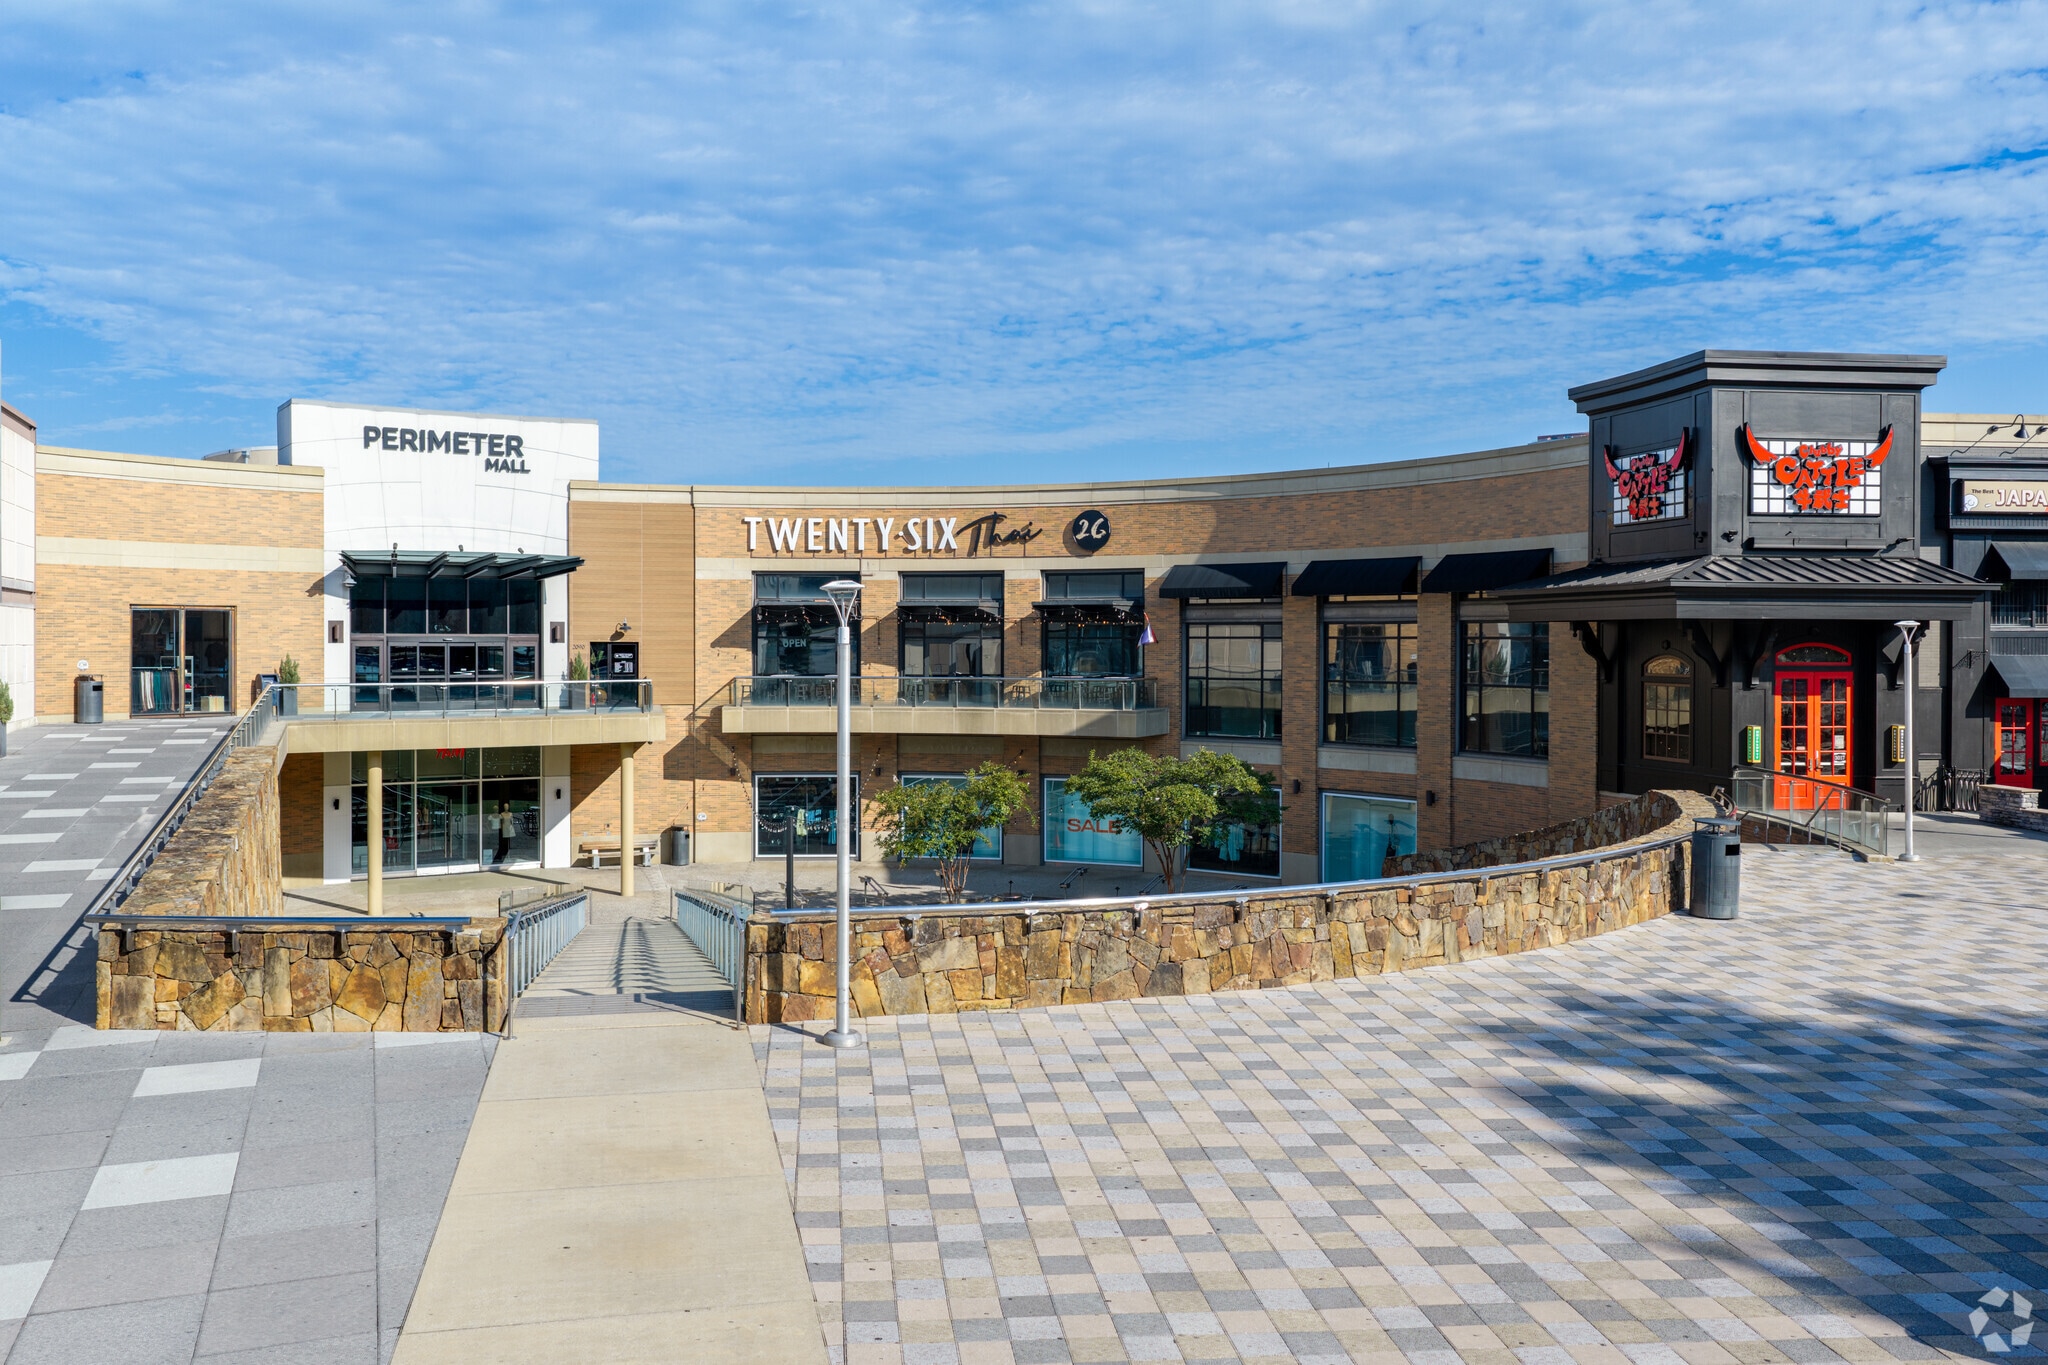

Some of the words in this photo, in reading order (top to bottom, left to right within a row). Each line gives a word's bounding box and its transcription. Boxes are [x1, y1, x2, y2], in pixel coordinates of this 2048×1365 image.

[363, 425, 525, 458] PERIMETER
[1799, 443, 1843, 459] Chubby
[484, 457, 531, 474] MALL
[1775, 456, 1866, 488] CATTLE
[1618, 464, 1669, 499] CATTLE
[744, 517, 895, 551] TWENTY
[907, 517, 958, 551] SIX
[956, 511, 1043, 557] Thai
[1074, 517, 1107, 540] 26
[782, 638, 807, 648] OPEN
